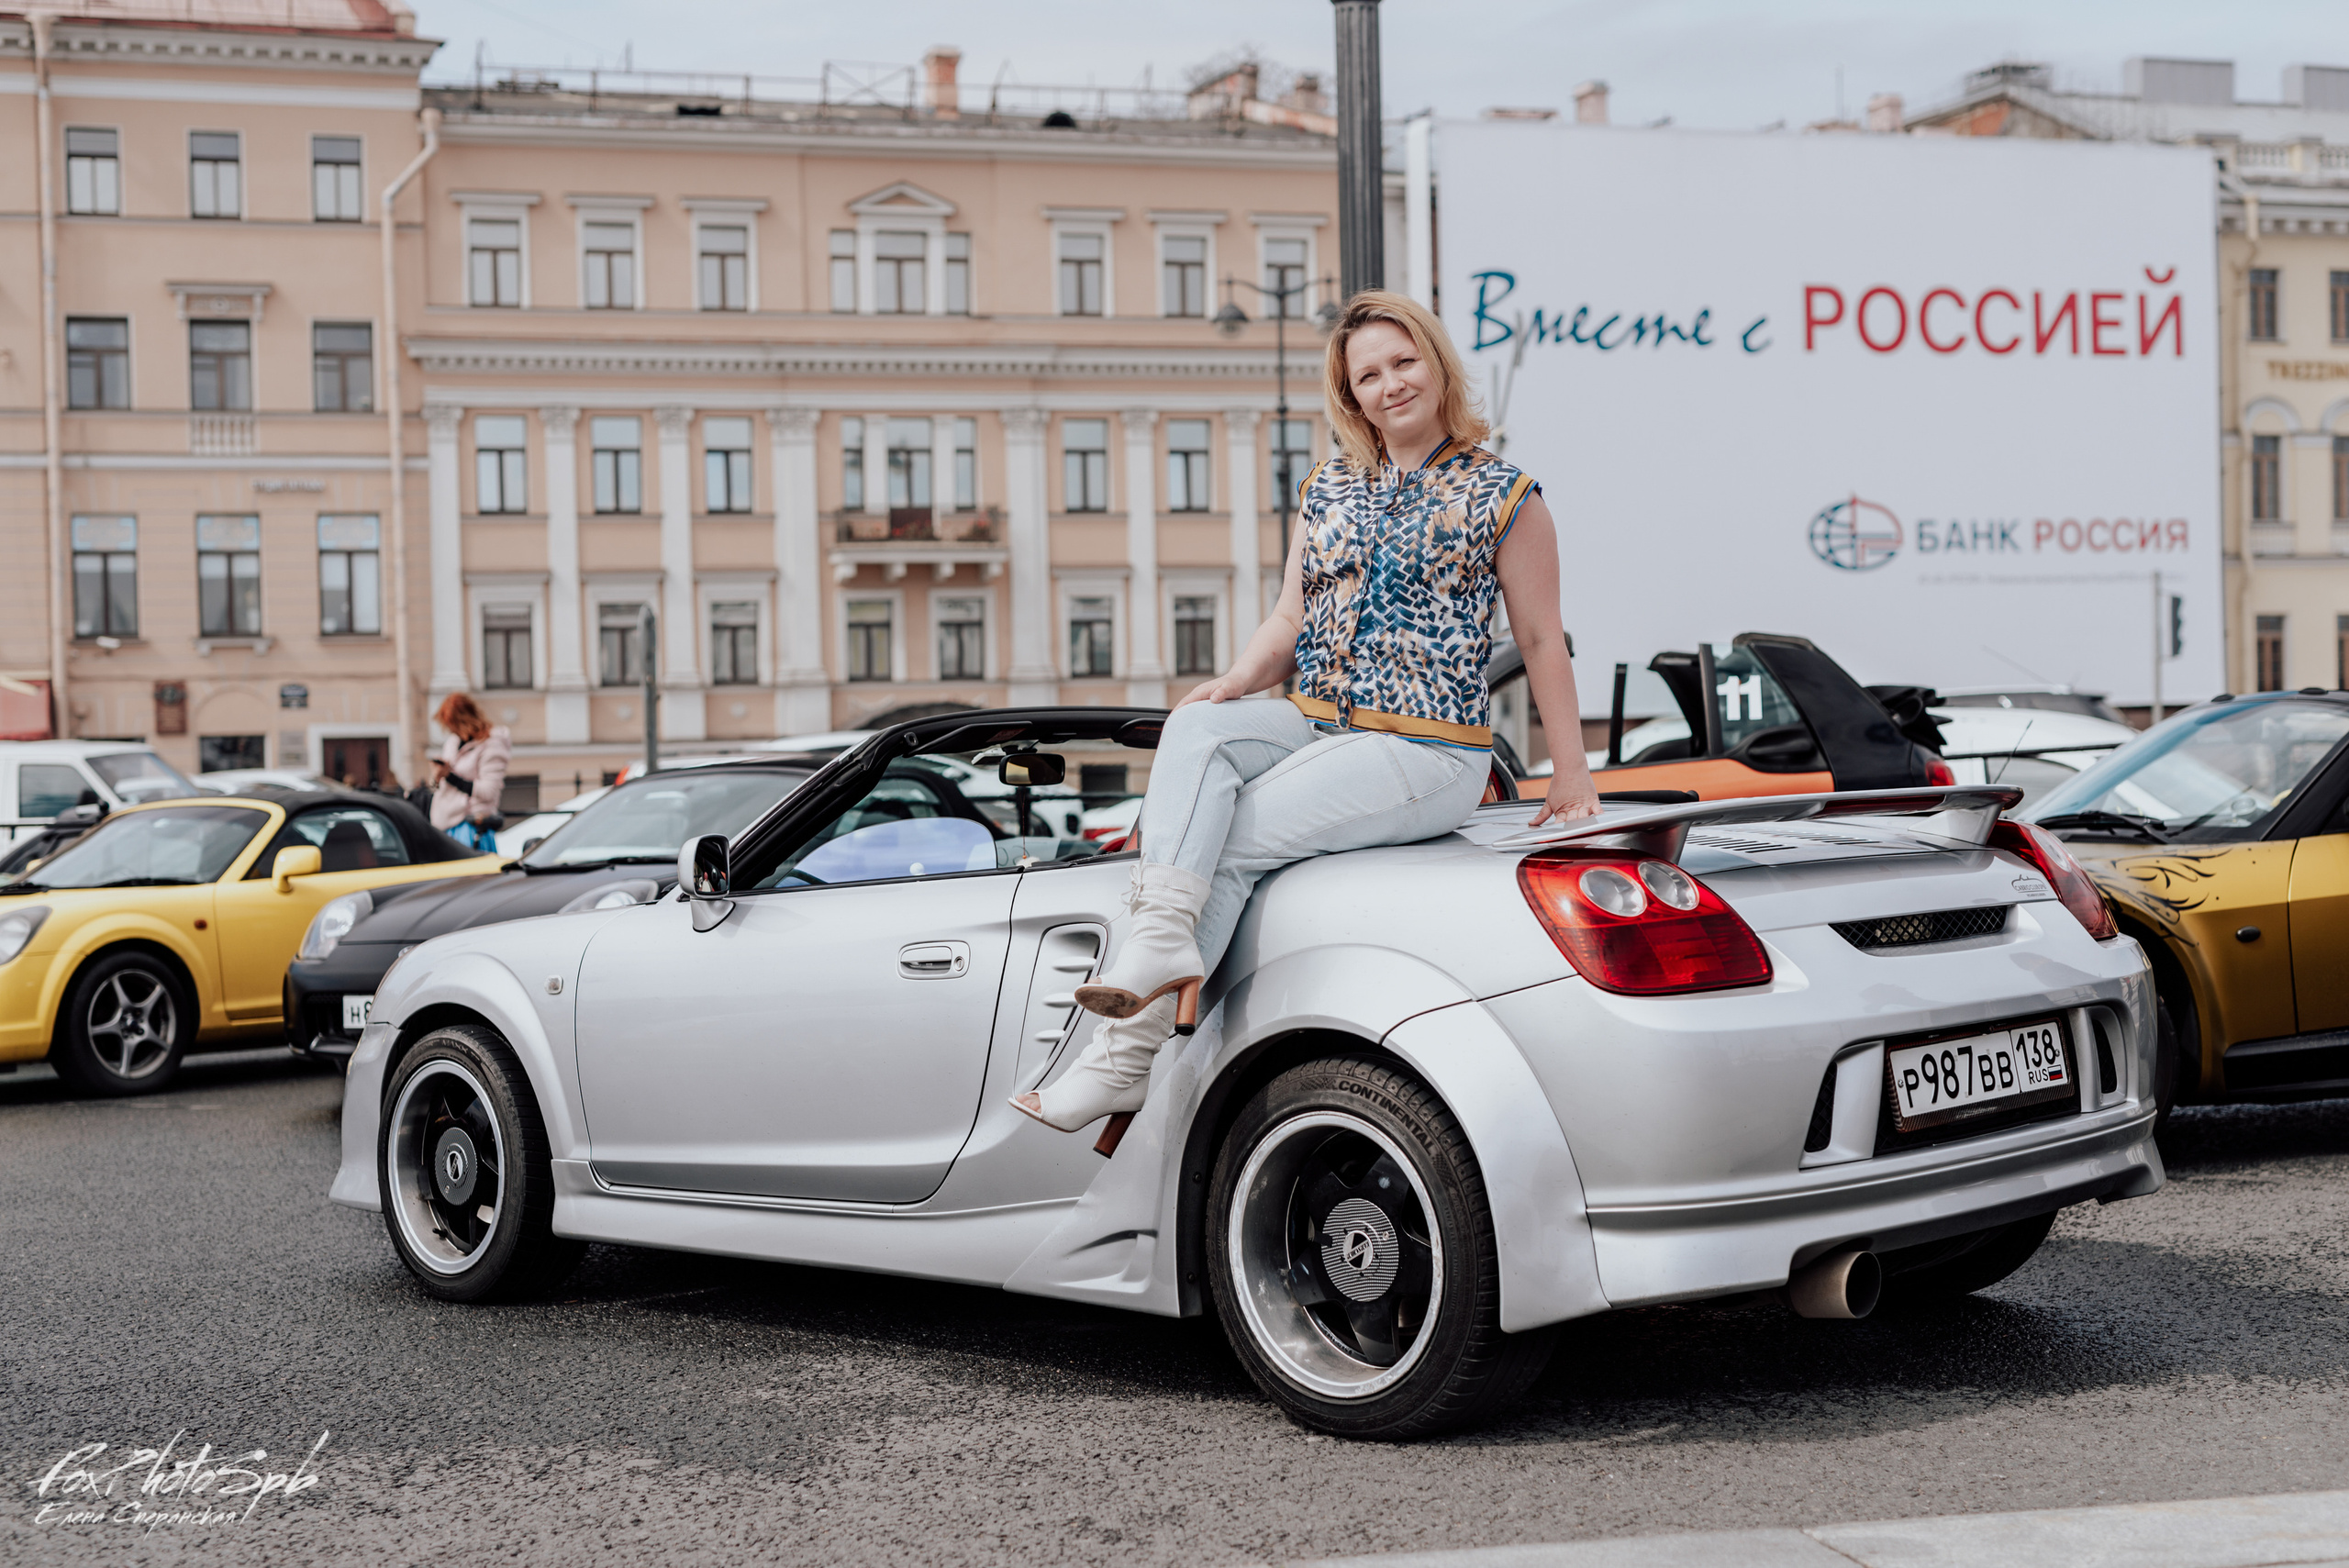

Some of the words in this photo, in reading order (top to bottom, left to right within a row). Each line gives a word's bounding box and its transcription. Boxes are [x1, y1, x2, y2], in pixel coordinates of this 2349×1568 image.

[1742, 317, 1771, 353] с
[1805, 268, 2183, 357] РОССИЕЙ
[1916, 518, 2021, 552] БАНК
[2033, 518, 2189, 552] РОССИЯ
[1717, 675, 1763, 720] 11
[2016, 1029, 2056, 1071] 138
[2029, 1068, 2049, 1085] RUS
[1339, 1080, 1433, 1157] CONTINENTAL
